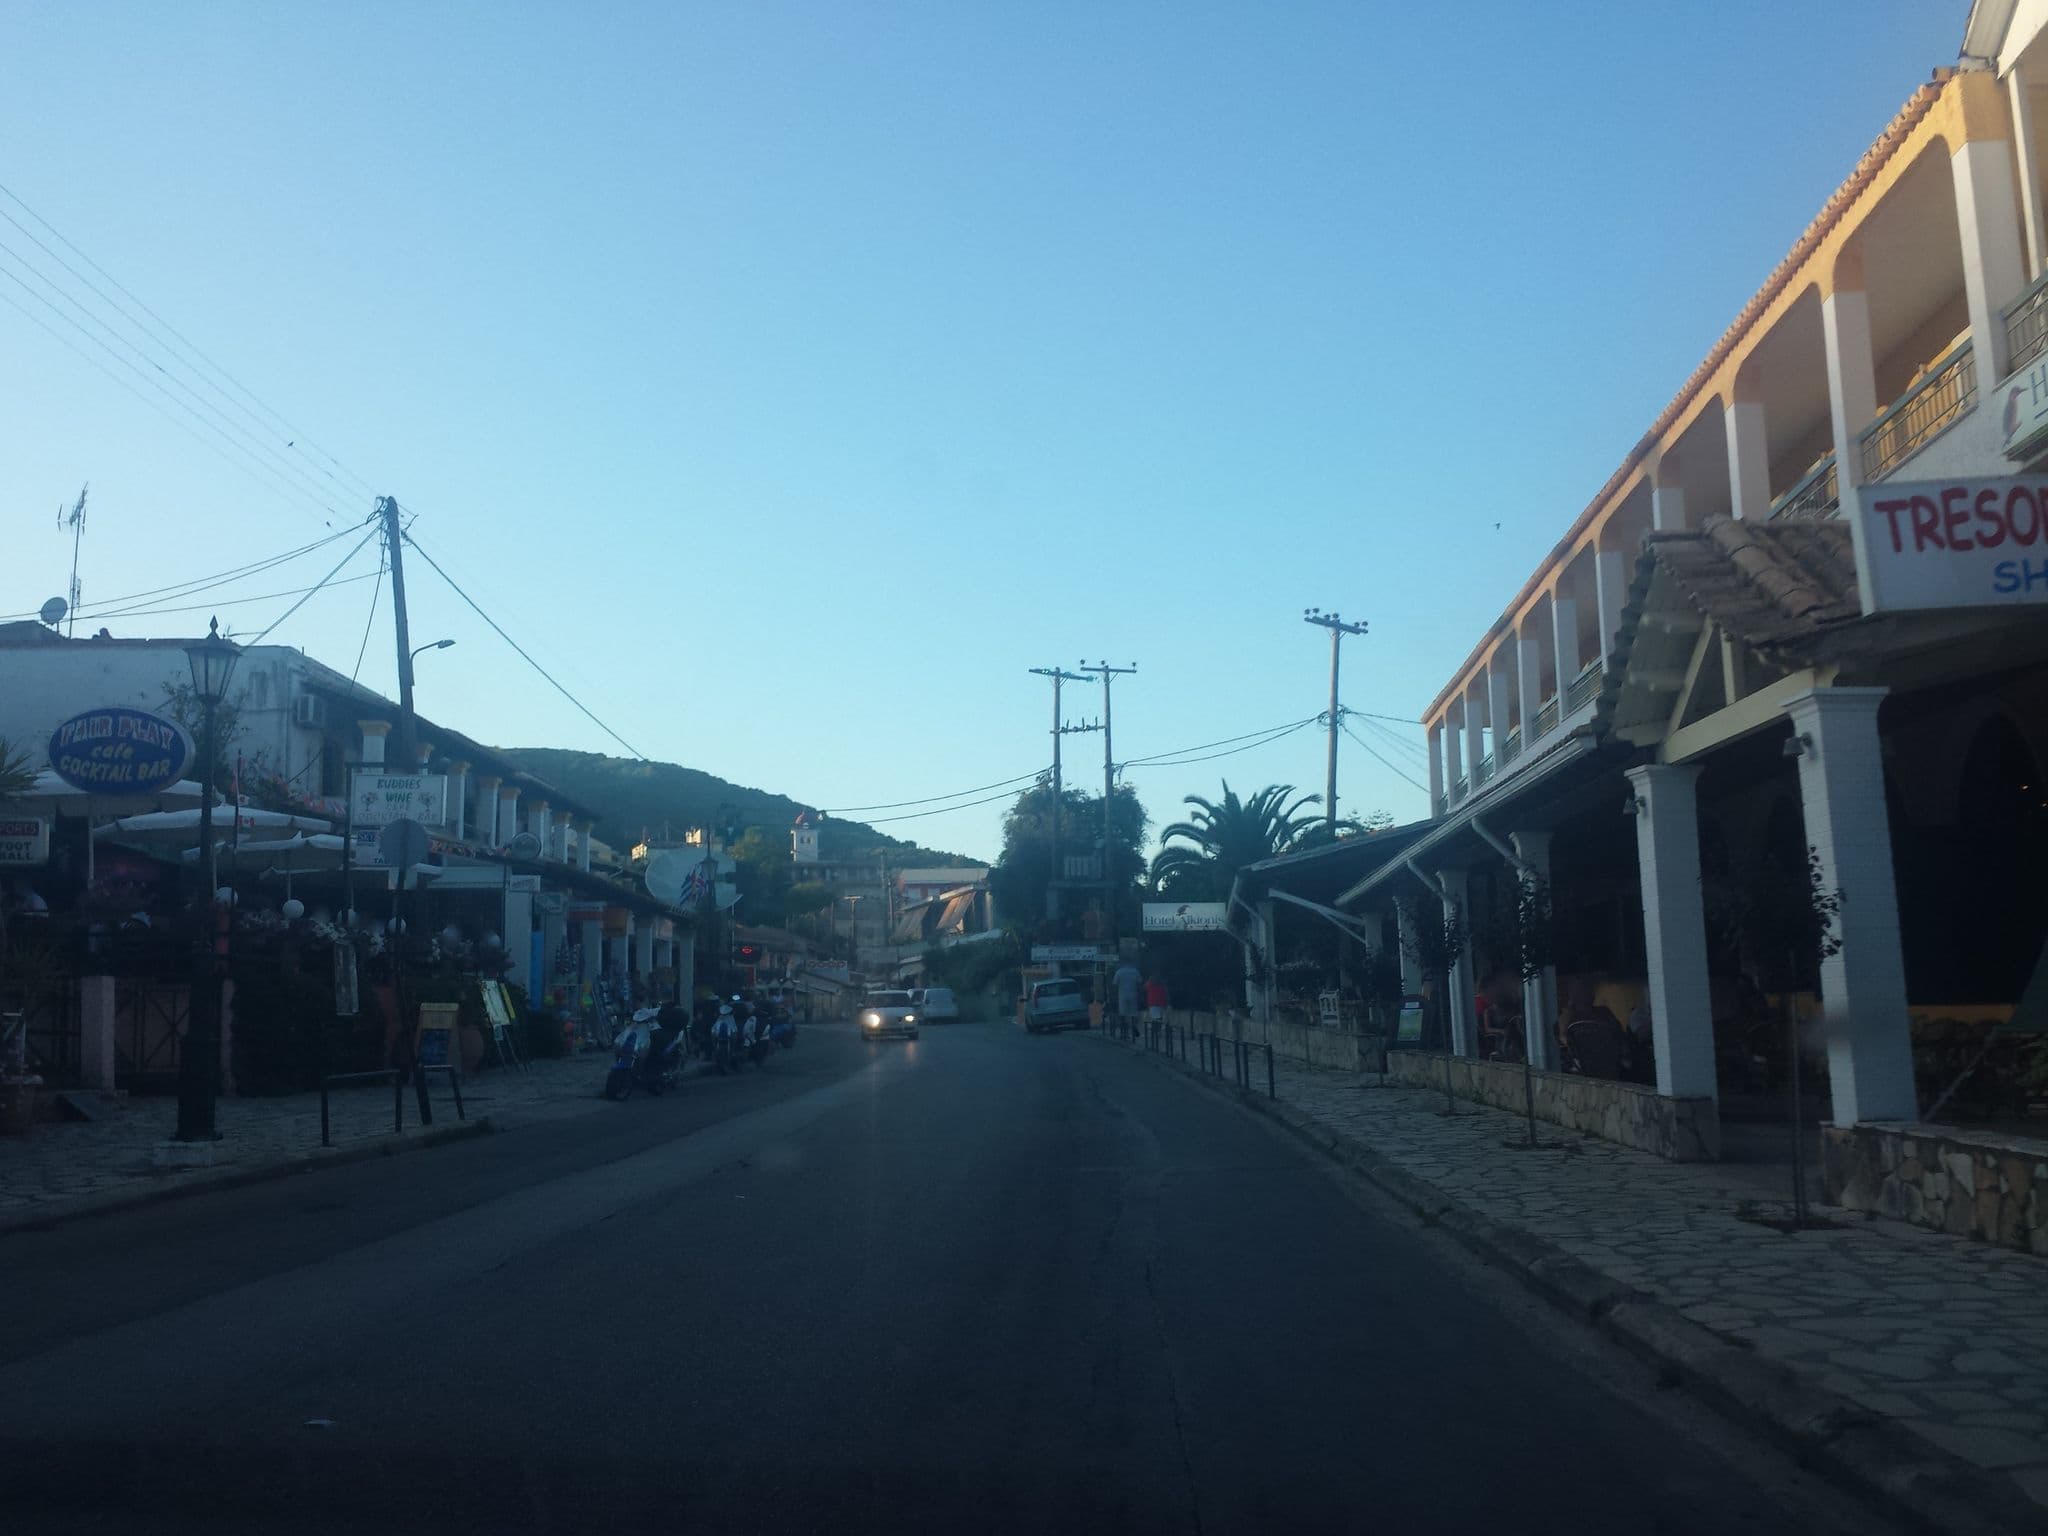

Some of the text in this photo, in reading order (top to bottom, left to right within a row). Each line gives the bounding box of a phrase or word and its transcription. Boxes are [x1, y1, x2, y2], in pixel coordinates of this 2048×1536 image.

[118, 715, 174, 752] PLAY
[60, 755, 171, 782] COCKTAIL BAR
